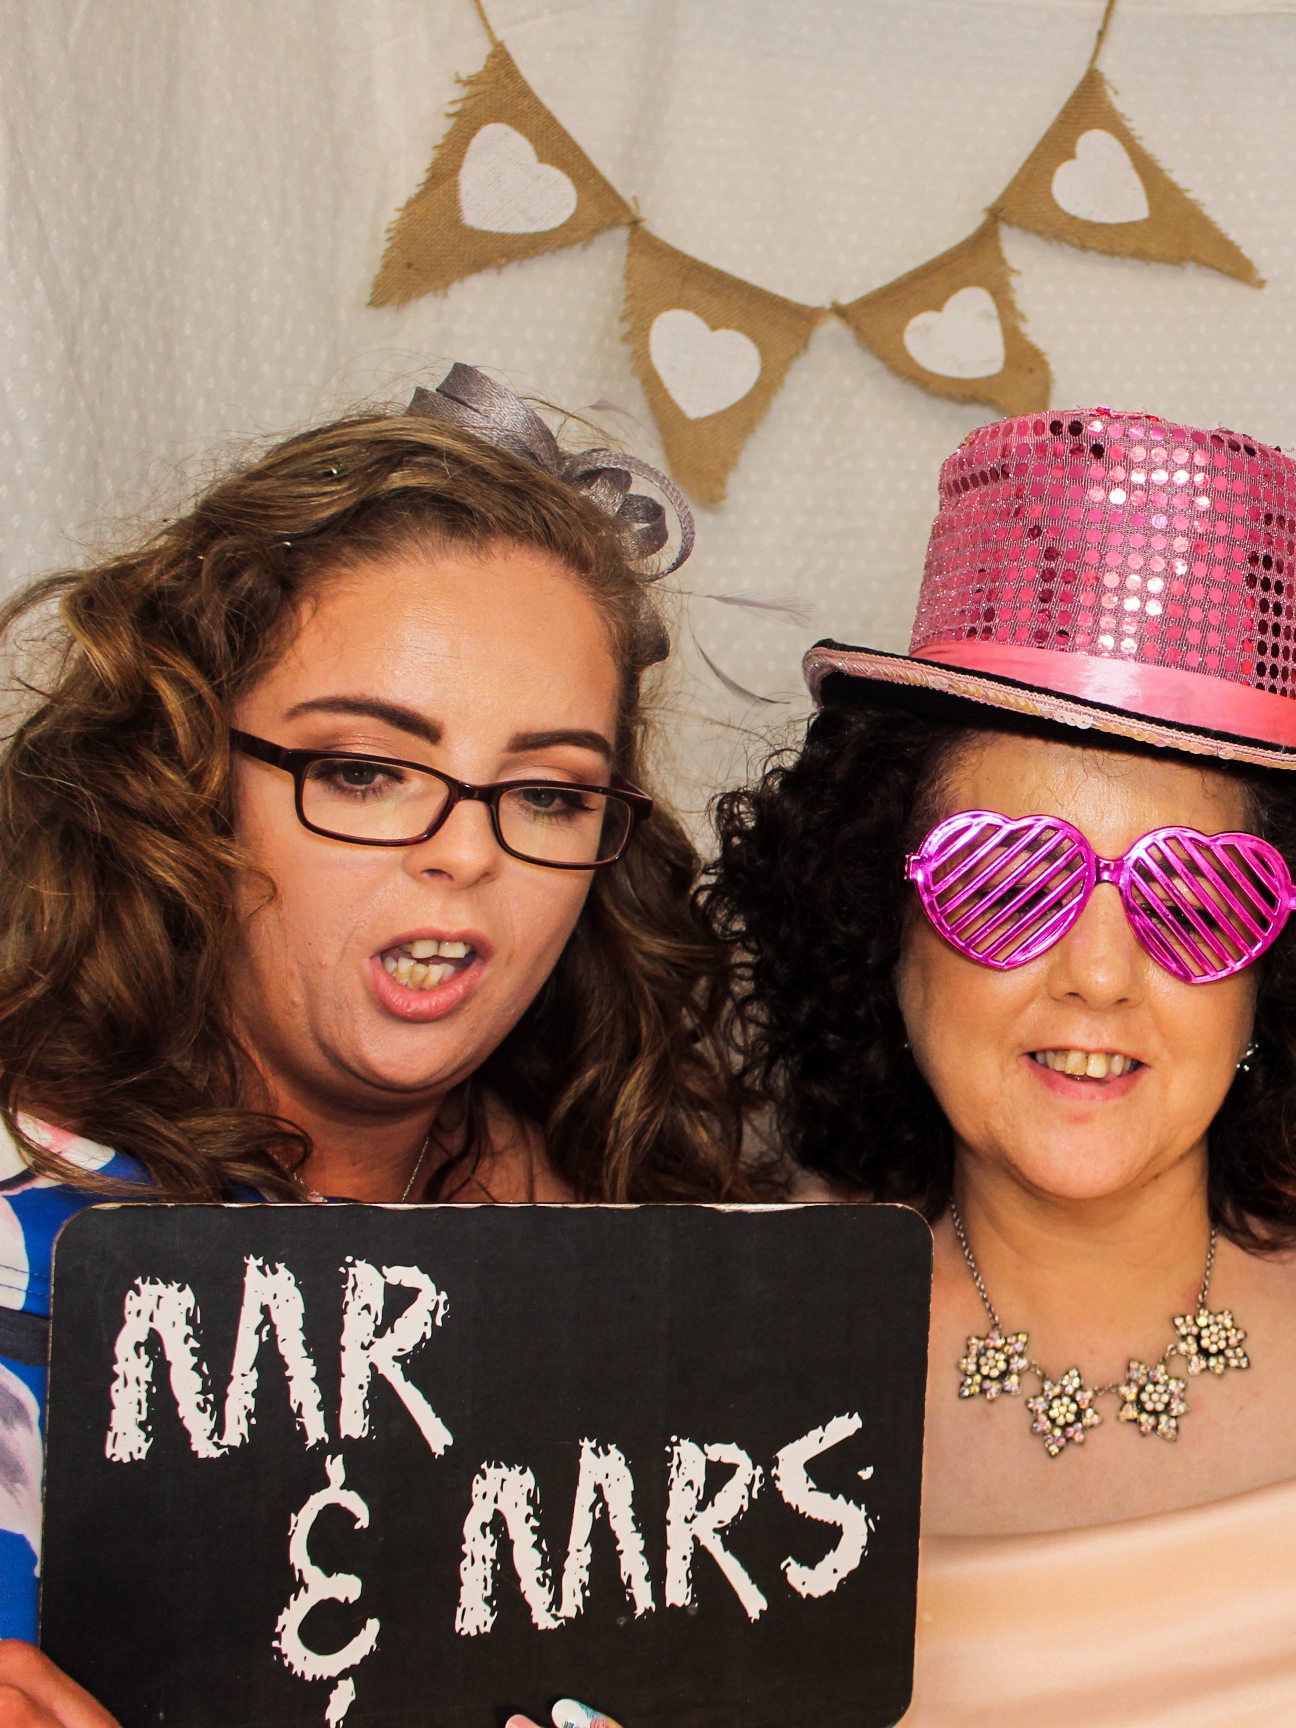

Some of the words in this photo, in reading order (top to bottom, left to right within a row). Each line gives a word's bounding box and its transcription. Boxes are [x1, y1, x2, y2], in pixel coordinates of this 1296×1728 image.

[105, 1254, 454, 1463] MR
[271, 1454, 381, 1728] &
[455, 1411, 879, 1636] MRS
